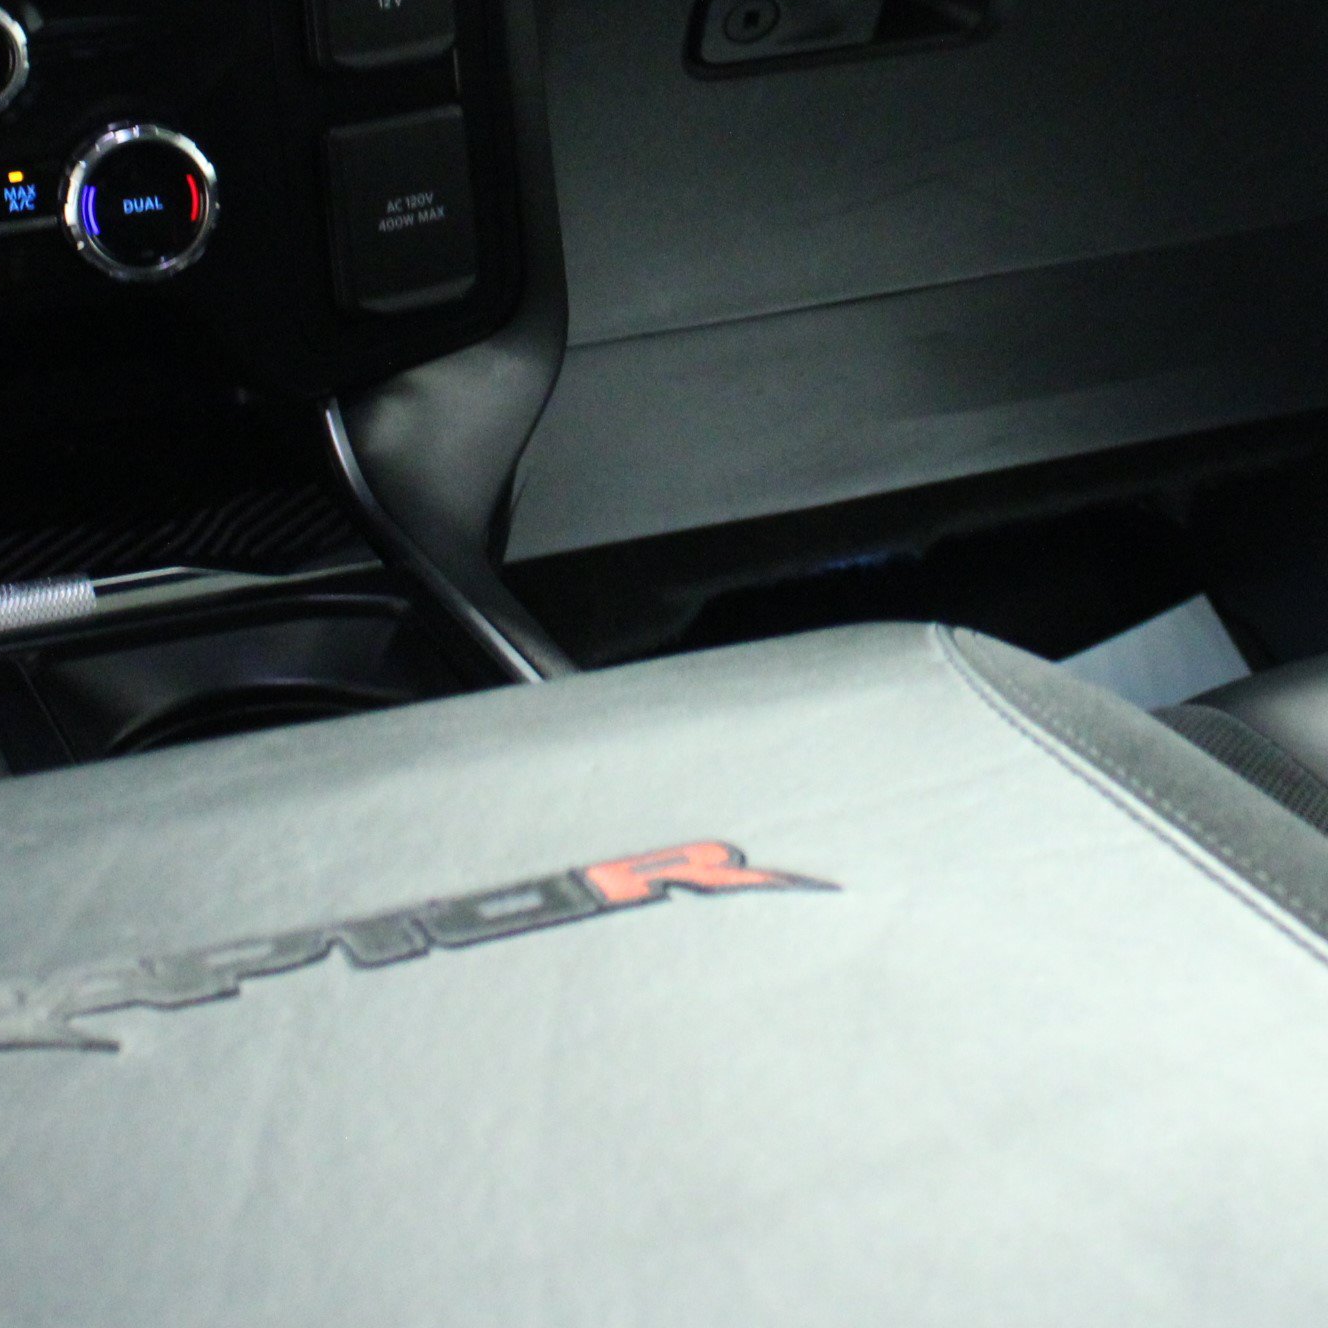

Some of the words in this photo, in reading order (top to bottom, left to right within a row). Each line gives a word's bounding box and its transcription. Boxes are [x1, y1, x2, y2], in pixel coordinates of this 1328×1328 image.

[4, 183, 36, 201] MAX
[8, 195, 35, 214] A/C
[122, 196, 164, 216] DUAL
[386, 197, 403, 215] AC
[418, 205, 446, 224] MAX
